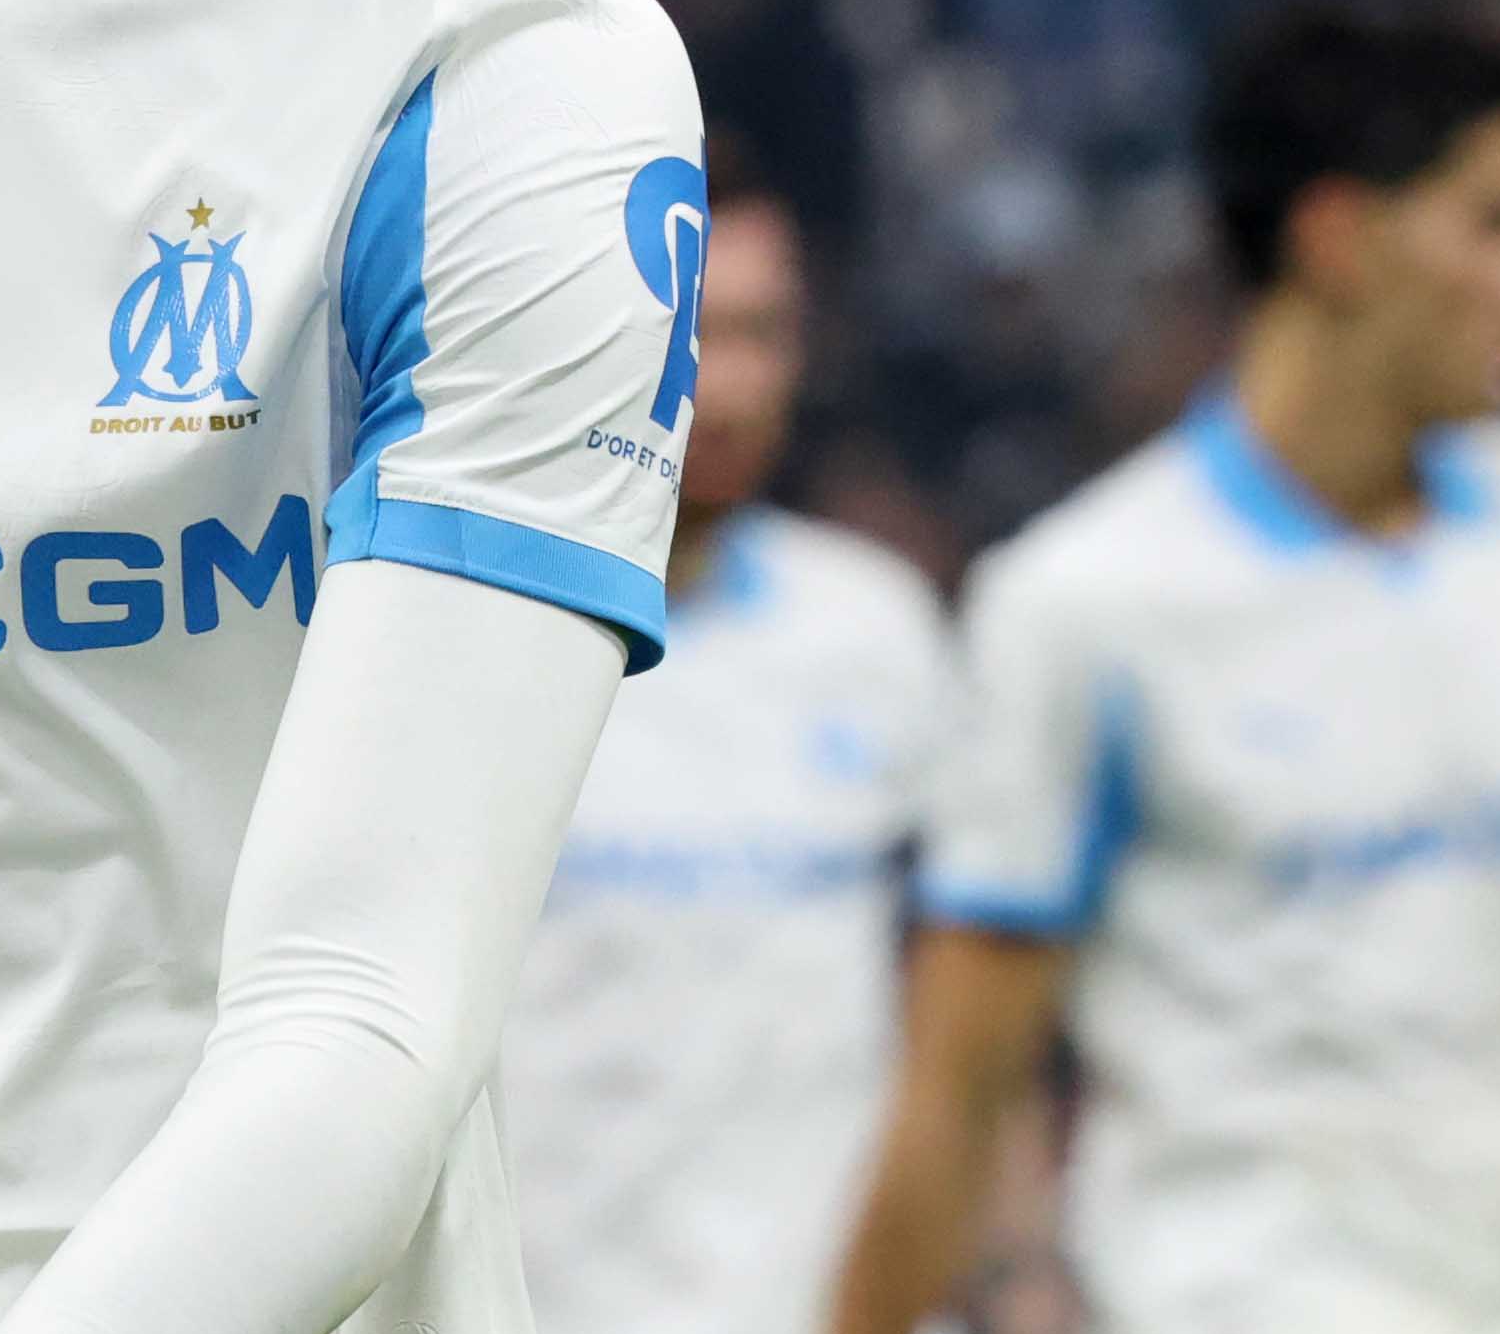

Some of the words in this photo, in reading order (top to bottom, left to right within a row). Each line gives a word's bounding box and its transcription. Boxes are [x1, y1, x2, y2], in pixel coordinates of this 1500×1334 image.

[90, 416, 165, 434] DROIT
[169, 416, 202, 433] AU
[209, 409, 262, 432] BUT
[587, 430, 637, 460] D'OR
[638, 446, 656, 470] ET
